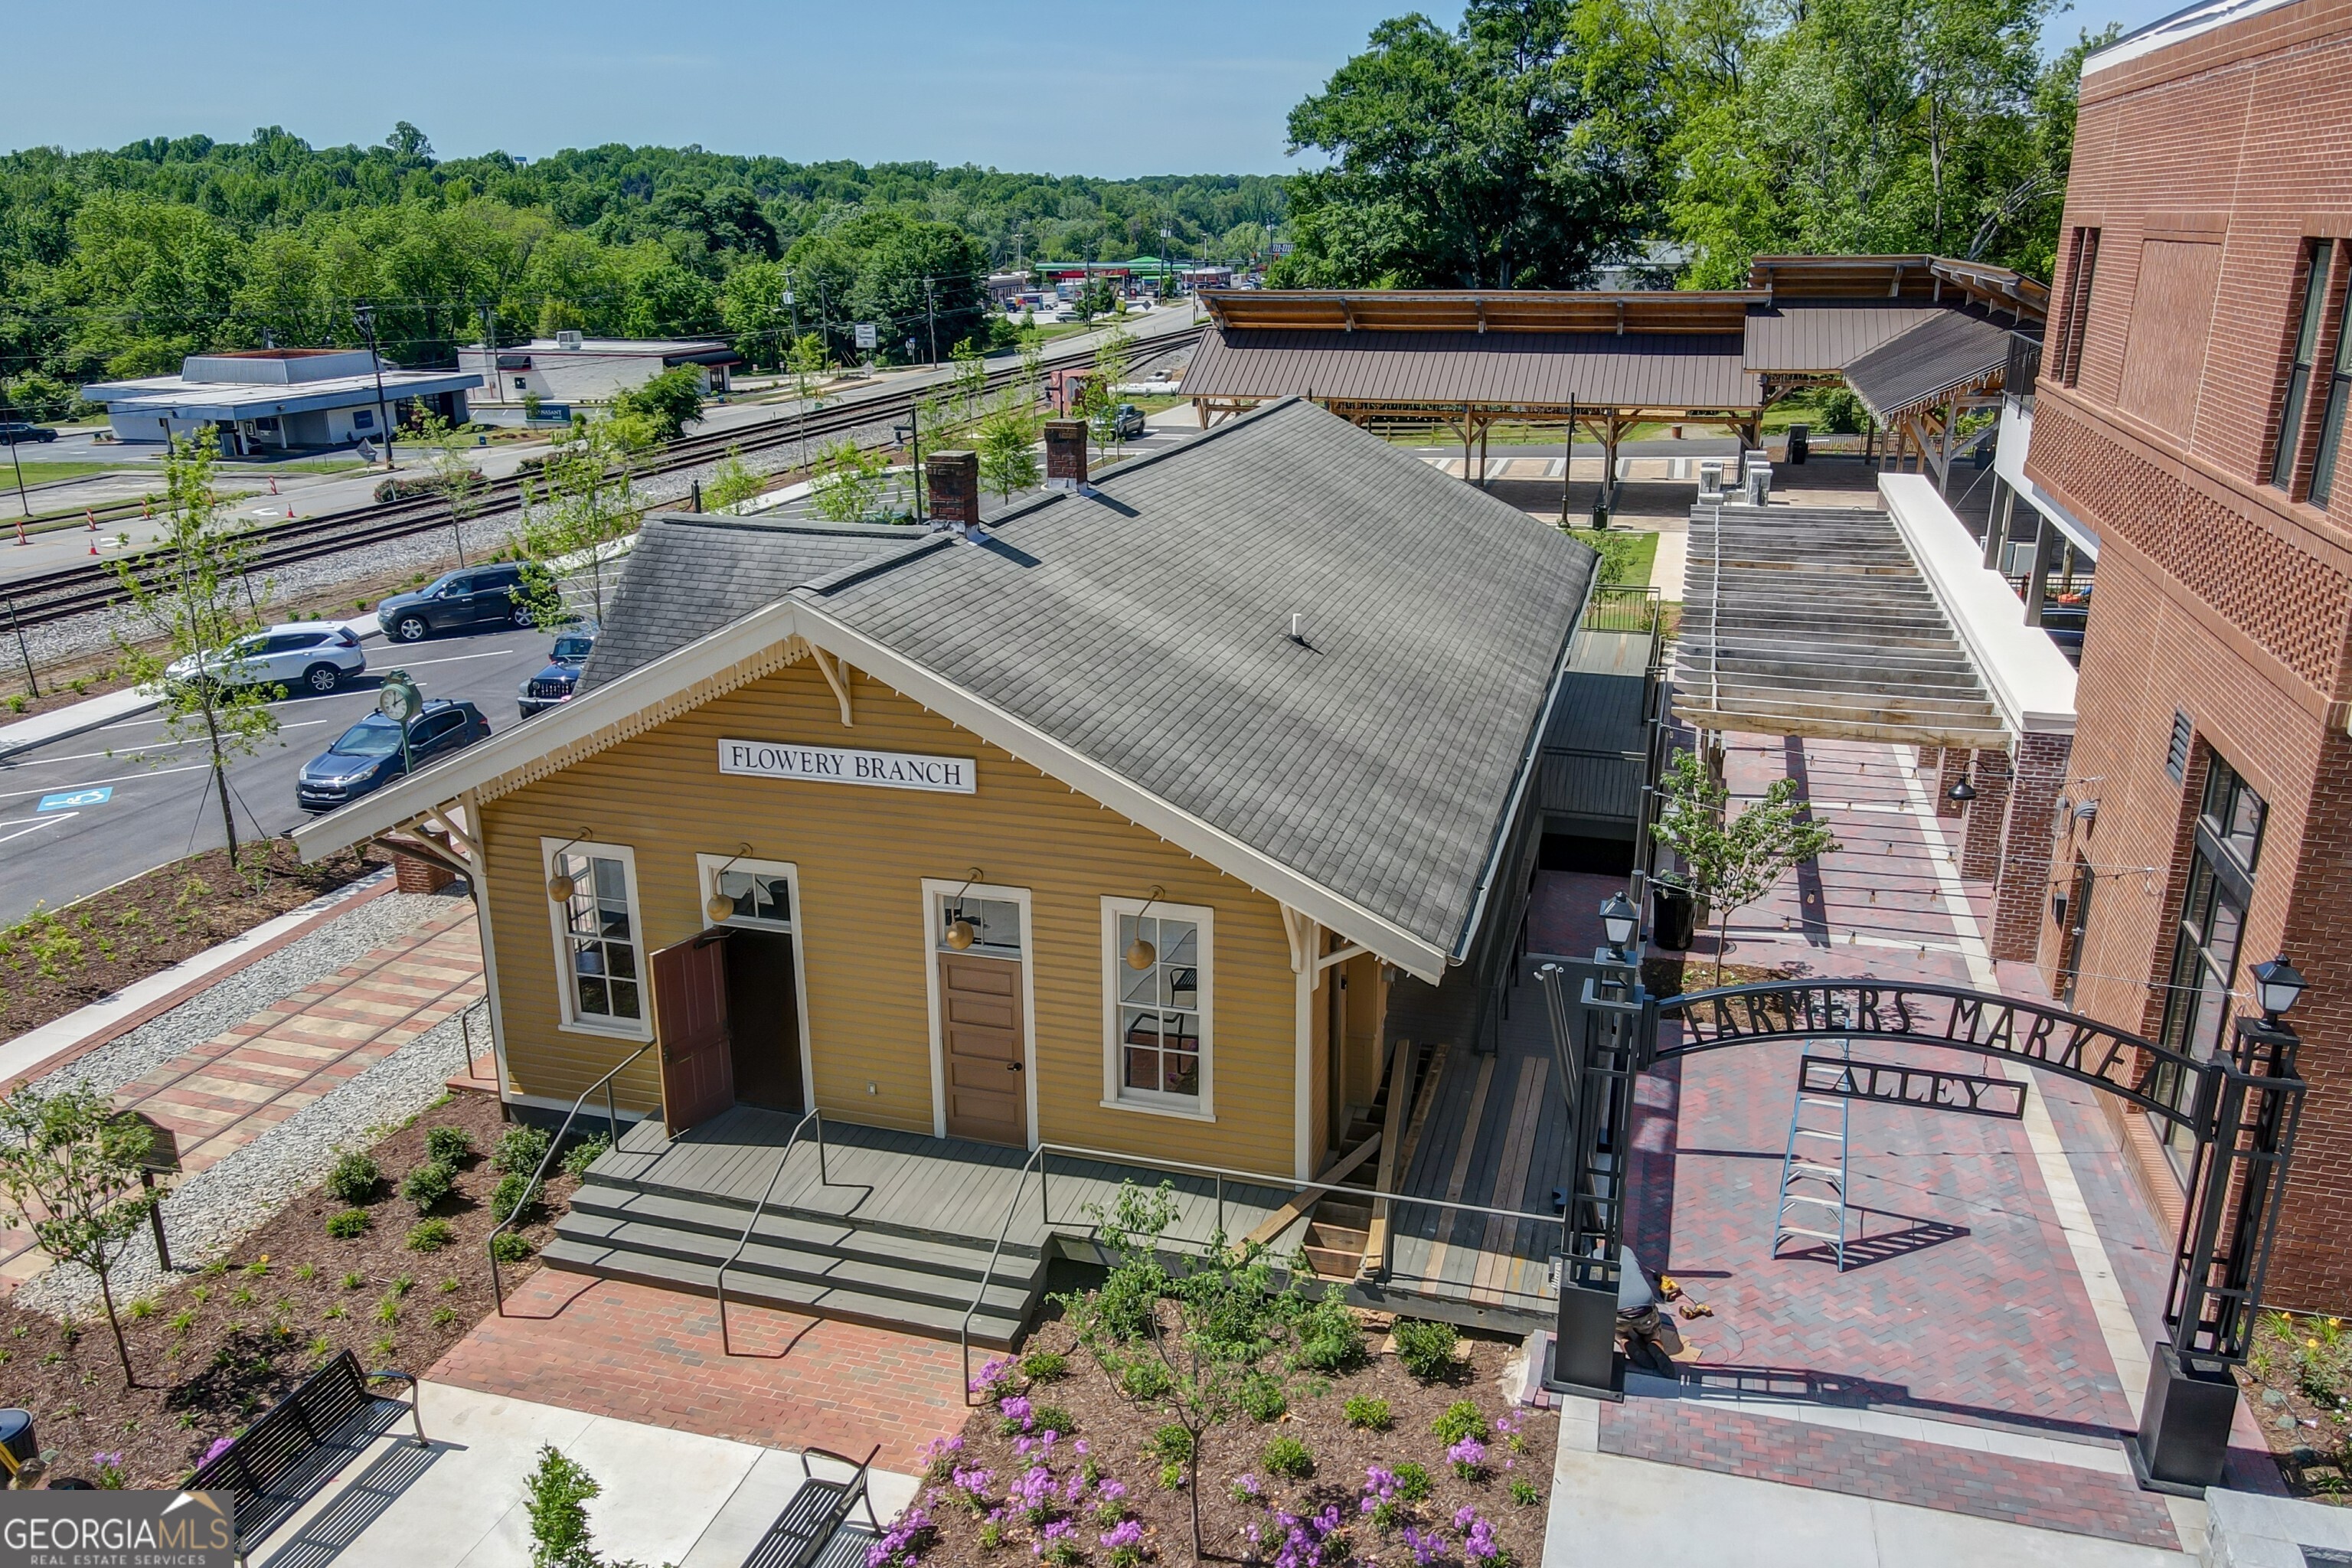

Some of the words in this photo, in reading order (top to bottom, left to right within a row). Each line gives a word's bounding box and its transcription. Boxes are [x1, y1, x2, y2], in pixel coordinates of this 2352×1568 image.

[731, 746, 844, 775] FLOWERY
[854, 756, 962, 786] BRANCH
[1684, 989, 1913, 1044] FARMERS
[1831, 1064, 1991, 1110] ALLEY
